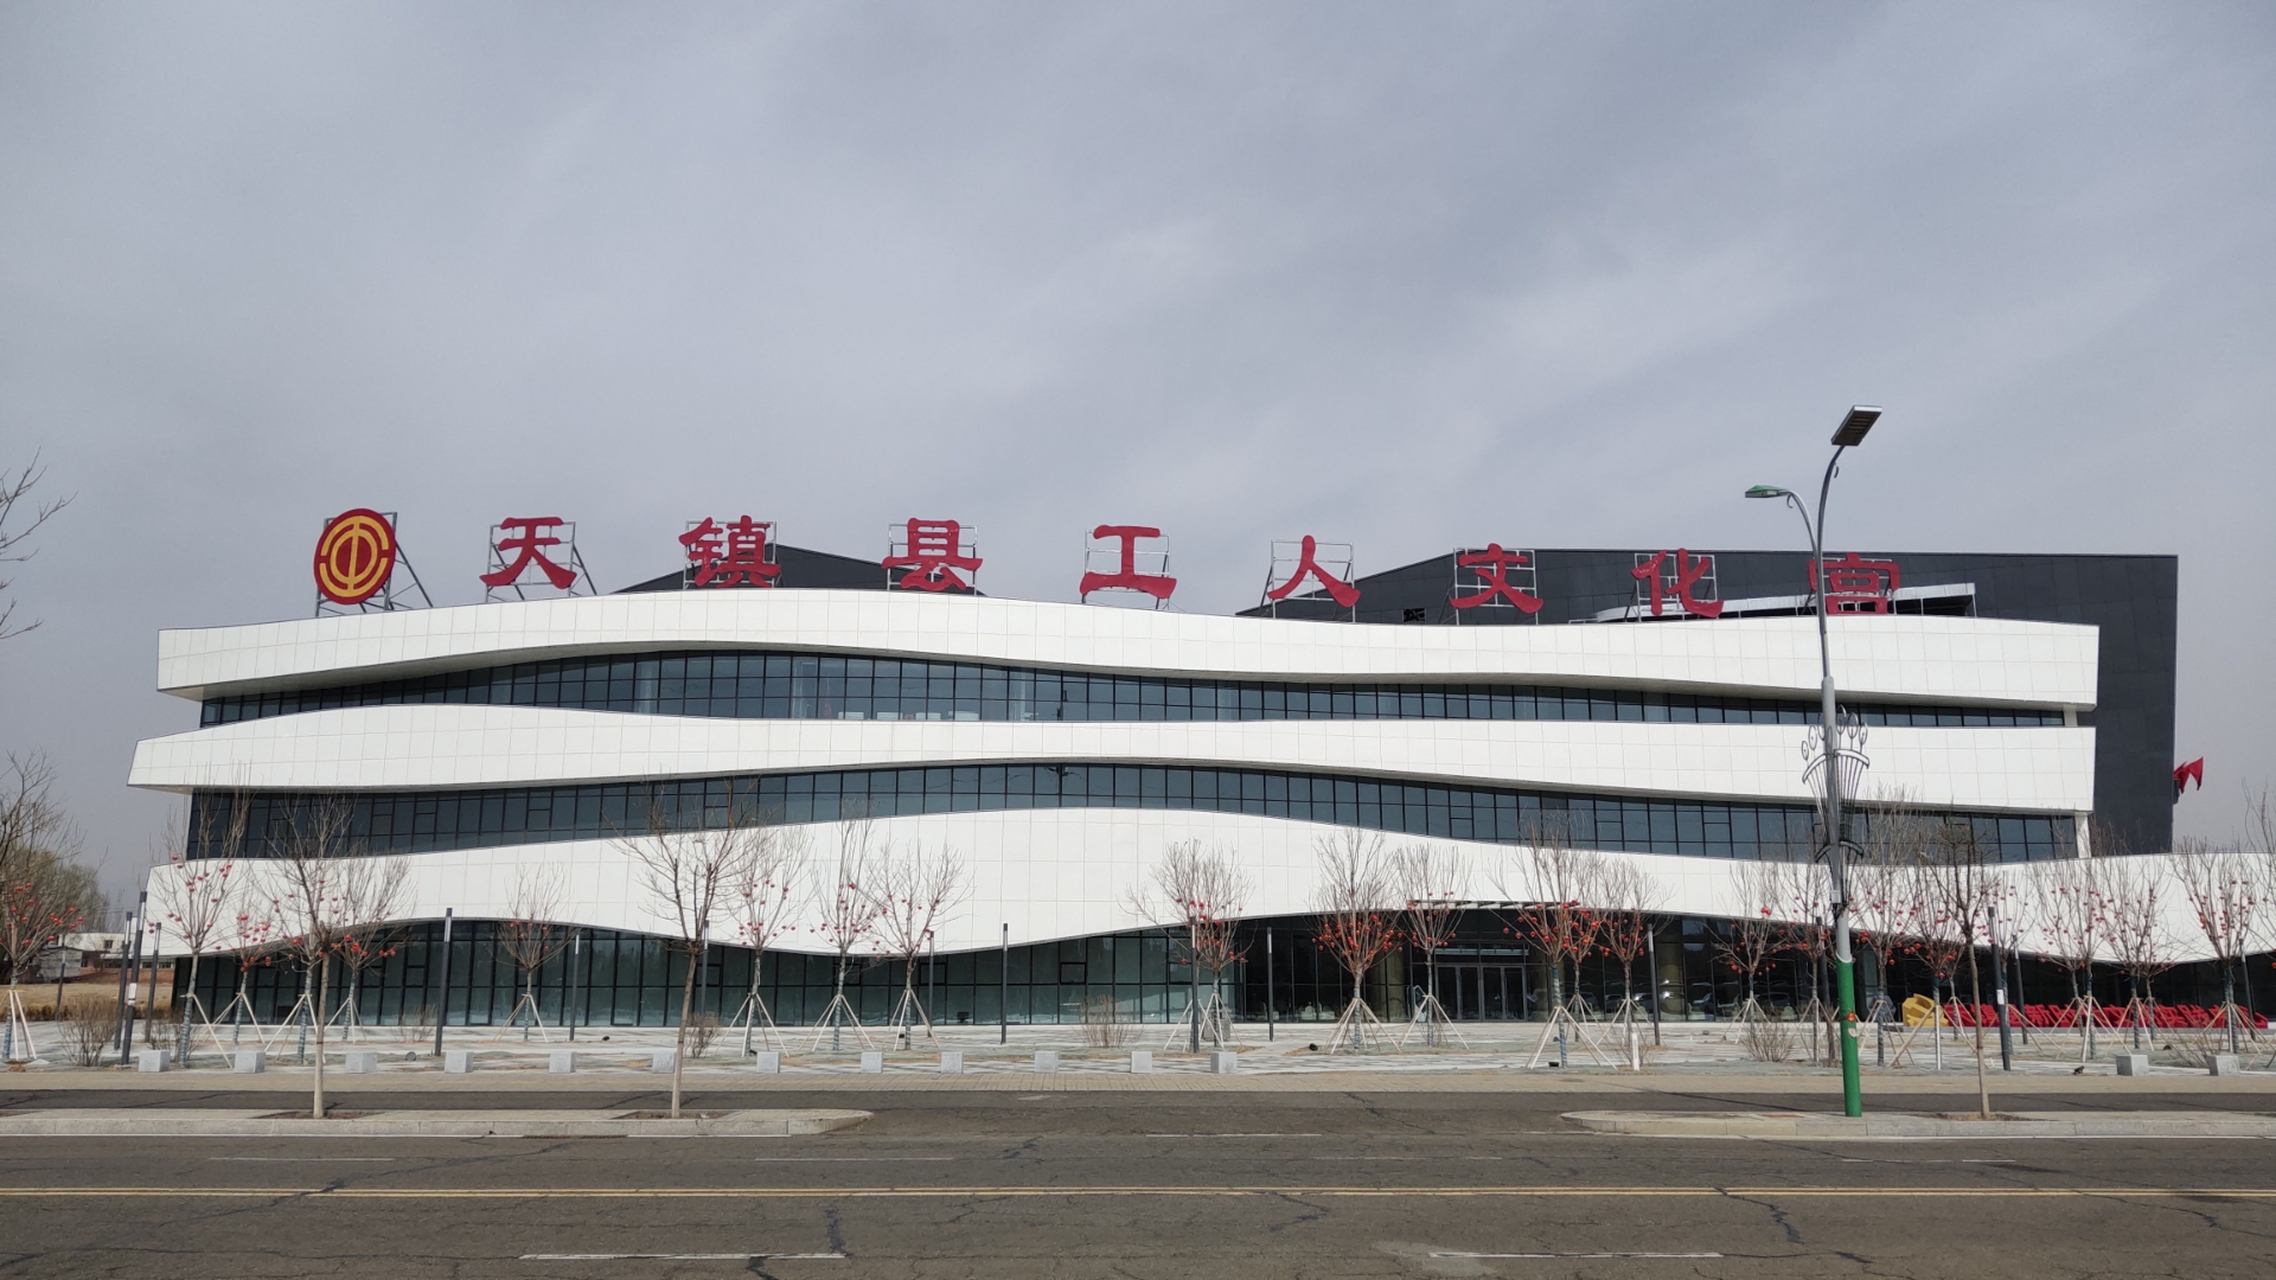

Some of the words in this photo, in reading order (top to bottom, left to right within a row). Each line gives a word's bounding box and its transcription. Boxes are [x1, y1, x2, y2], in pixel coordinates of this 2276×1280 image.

[479, 515, 1900, 617] 天镇县工人文化宫
